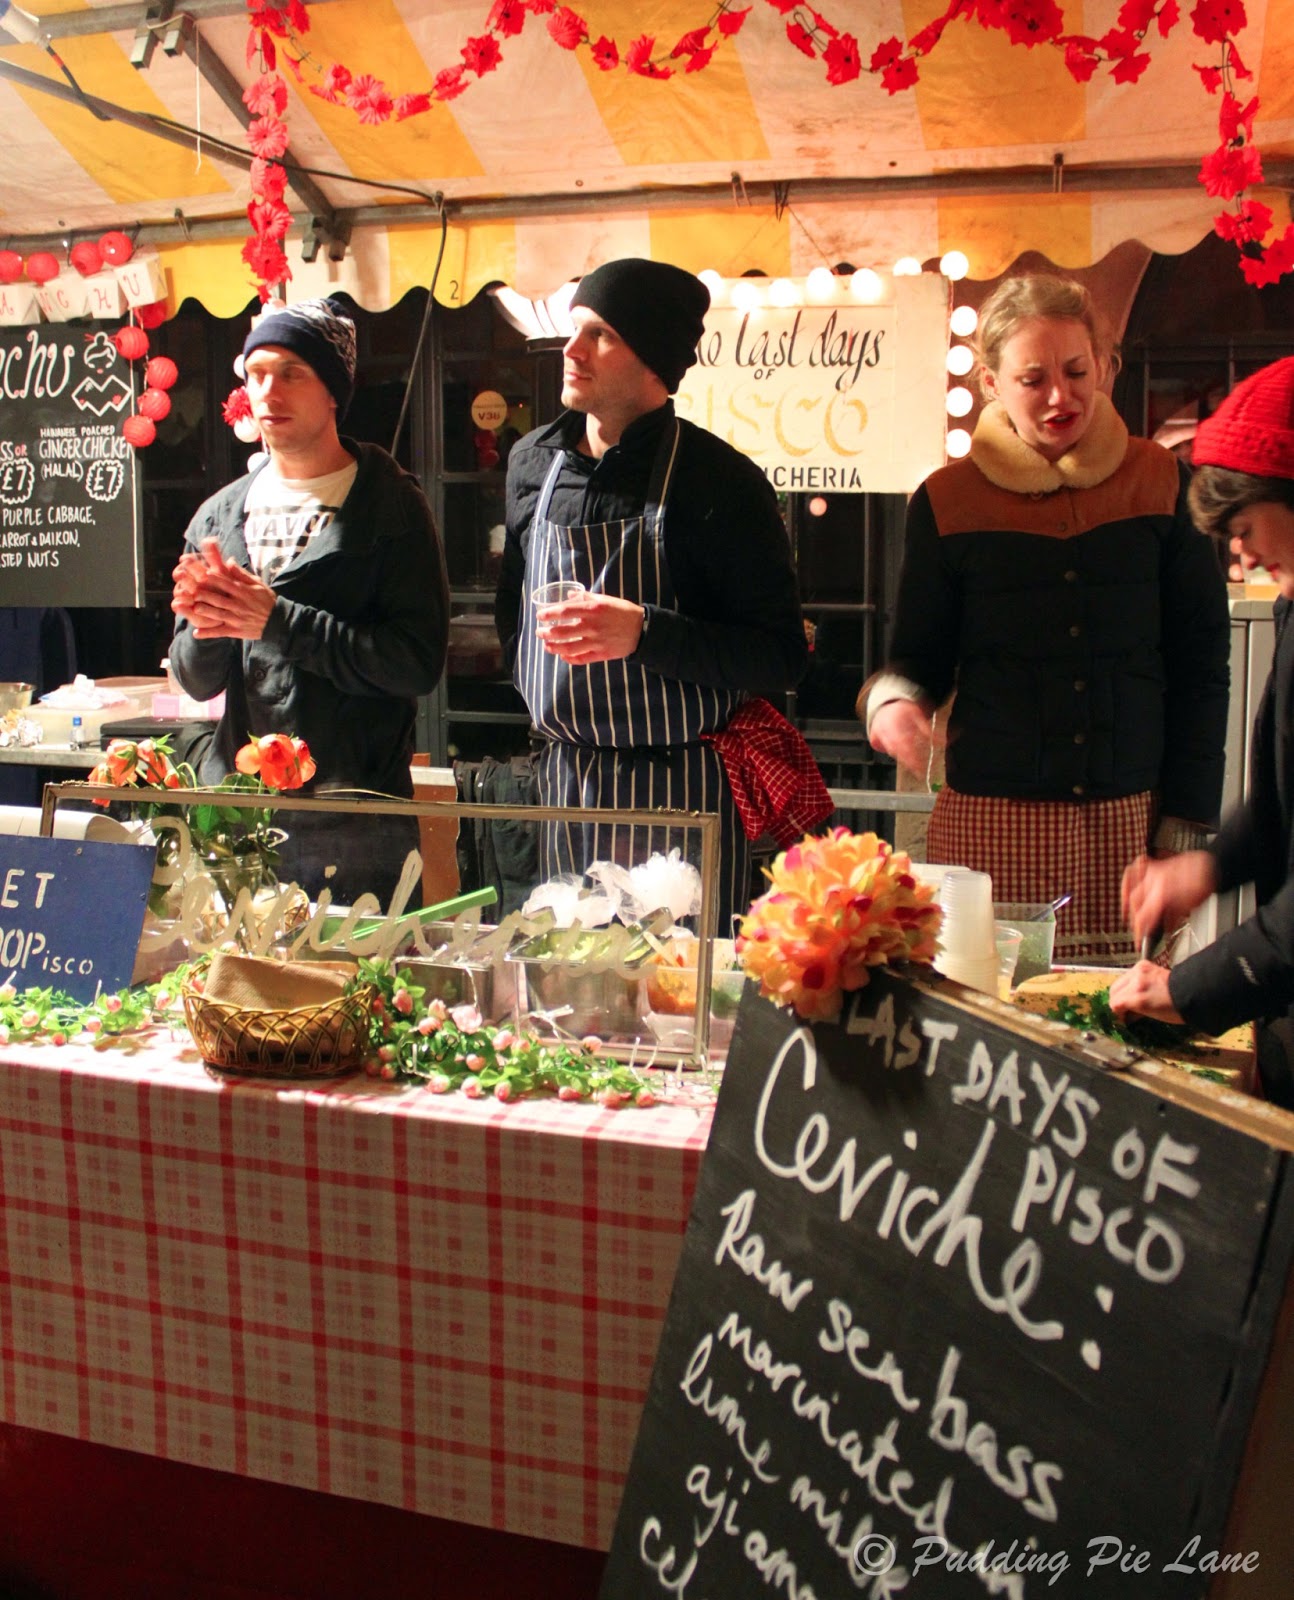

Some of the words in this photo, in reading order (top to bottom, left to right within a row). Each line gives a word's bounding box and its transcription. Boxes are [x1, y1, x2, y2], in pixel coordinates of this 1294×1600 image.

[449, 280, 460, 300] 2
[734, 309, 804, 368] last
[808, 309, 886, 392] days
[753, 368, 777, 381] OF
[81, 425, 115, 436] POACHED
[39, 437, 82, 459] GINGER
[2, 465, 27, 490] £7
[93, 466, 118, 494] £7
[3, 508, 43, 527] PURPLE
[0, 552, 22, 568] STED
[28, 550, 59, 568] NUTS
[846, 993, 959, 1077] LAST
[952, 1040, 1100, 1158] DAYS
[1111, 1127, 1201, 1202] OF
[1011, 1145, 1185, 1284] PISCO
[715, 1189, 813, 1312] Raw
[928, 1345, 1064, 1523] bass
[680, 1333, 780, 1484] lime
[718, 1312, 962, 1555] marinated
